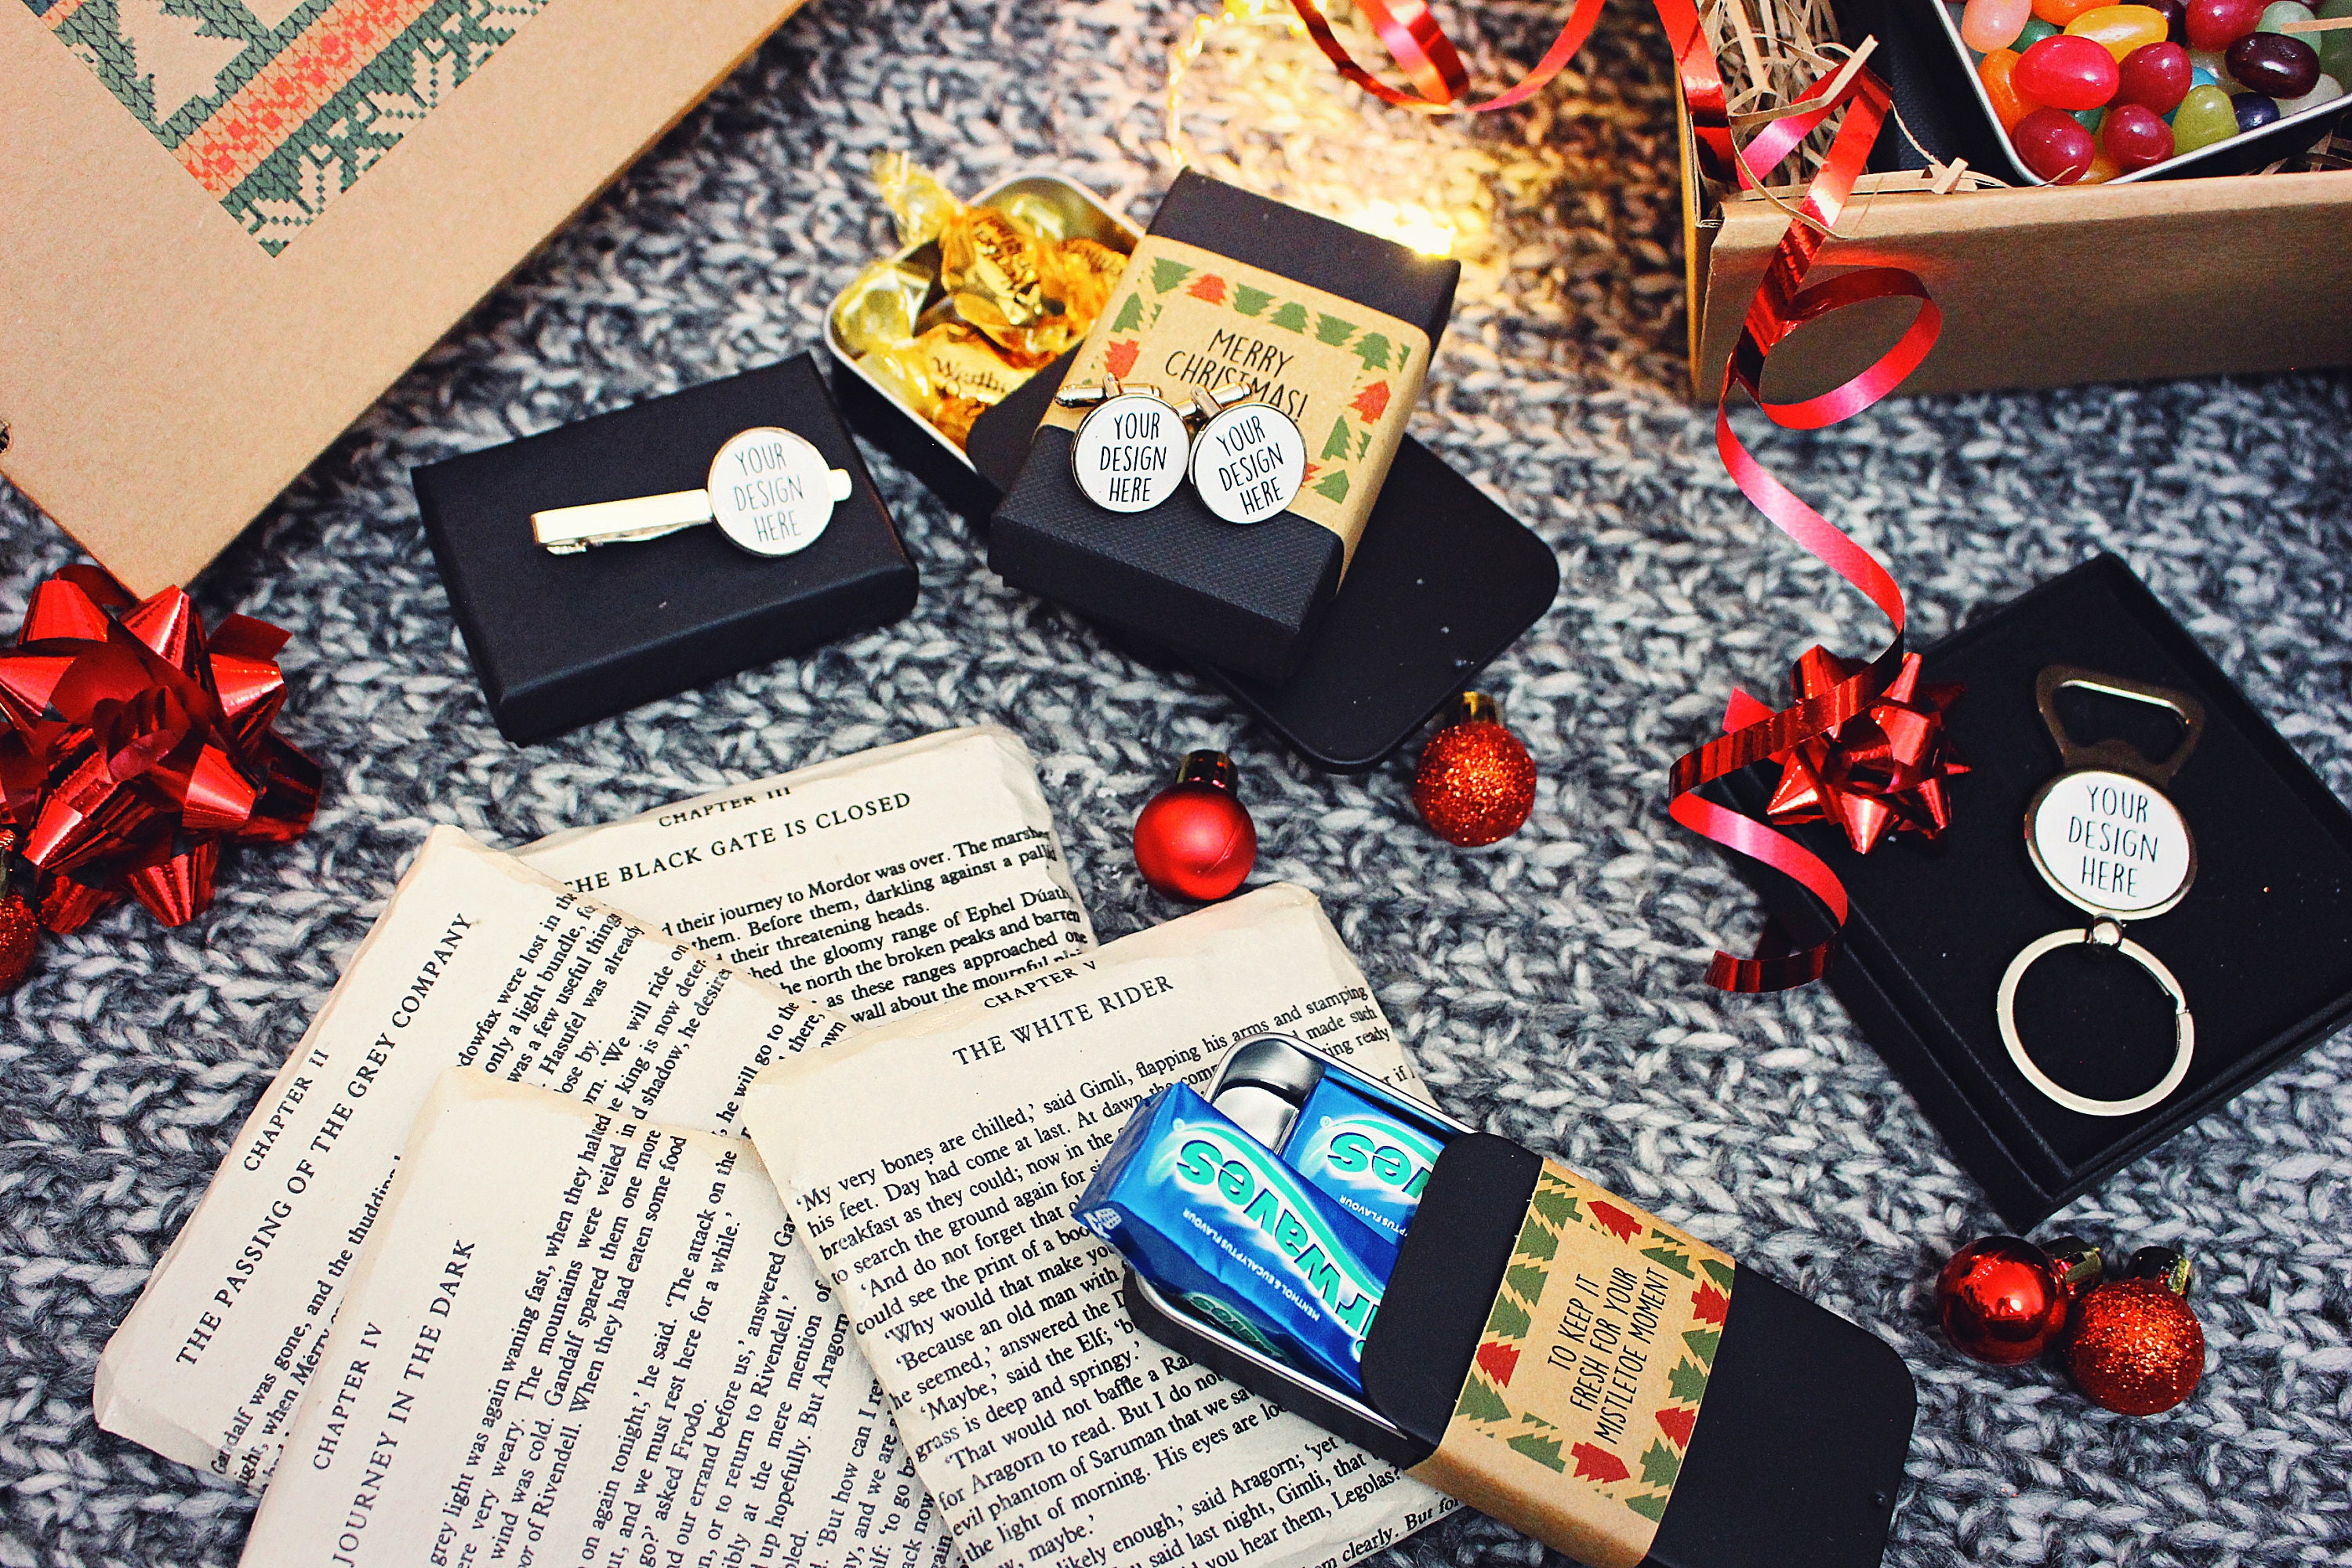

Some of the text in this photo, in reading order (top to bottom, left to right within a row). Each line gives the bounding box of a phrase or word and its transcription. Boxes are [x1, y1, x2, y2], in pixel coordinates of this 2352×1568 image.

[1207, 328, 1294, 379] MERRY
[734, 442, 787, 477] YOUR
[1099, 445, 1167, 472] DESIGN
[1113, 412, 1161, 441] YOUR
[1215, 415, 1266, 457] YOUR
[1218, 441, 1285, 492] DESIGN
[733, 474, 804, 512] DESIGN
[753, 510, 802, 543] HERE
[1109, 477, 1153, 503] HERE
[1240, 476, 1285, 516] HERE
[562, 792, 910, 894] HE BLACK GATE IS CLOSED
[658, 794, 757, 827] CHAPTER
[2068, 815, 2158, 863] DESIGN
[2086, 784, 2149, 824] YOUR
[675, 840, 989, 935] their journey to Mordor was over. The
[746, 856, 1014, 937] Before them, darkling against a
[2082, 855, 2140, 898] HERE
[495, 913, 561, 1004] were lost in
[729, 900, 930, 964] their threatening heads.
[788, 895, 1016, 971] the gloomy range of Ephel
[484, 924, 587, 1073] only a light bundle,
[505, 954, 593, 1083] was a few useful
[537, 924, 646, 1076] Hasufel was already
[951, 975, 1174, 1065] THE WHITE RIDER
[982, 959, 1096, 1008] CHAPTER V
[243, 1047, 329, 1171] CHAPTER II
[837, 1167, 876, 1191] very
[879, 1146, 935, 1174] bones
[938, 1134, 967, 1154] are
[1042, 1087, 1077, 1114] said
[1079, 1069, 1134, 1099] Gimli,
[1134, 1045, 1202, 1079] flapping
[1200, 1033, 1229, 1054] his
[1231, 1019, 1269, 1043] arms
[1272, 1003, 1303, 1027] and
[1305, 985, 1369, 1014] stamping
[174, 912, 473, 1365] THE PASSING OF THE GREY COMPANY
[805, 1110, 1099, 1239] his feet. Day had come at last. At
[818, 1131, 1116, 1261] breakfast as they could; now in the
[852, 1170, 1087, 1274] search the ground again for
[1339, 1195, 1382, 1229] FLAVOUR
[513, 1142, 627, 1402] The mountains were veiled
[543, 1129, 662, 1406] Gandalf spared them one more
[1182, 1207, 1322, 1323] MENTHOL & EUCALYPTUS FLAVOUR
[248, 1248, 354, 1405] was gone, and the
[429, 1112, 612, 1566] grey light was again waning fast, when they halted
[1547, 1272, 1600, 1370] TO KEEP IT
[1570, 1266, 1639, 1412] FRESH FOR YOUR
[1593, 1266, 1670, 1445] MISTLETOE MOMENT
[312, 1320, 383, 1471] CHAPTER IV
[331, 1238, 476, 1567] JOURNEY IN THE DARK
[995, 1413, 1260, 1544] light of morning. His eyes are
